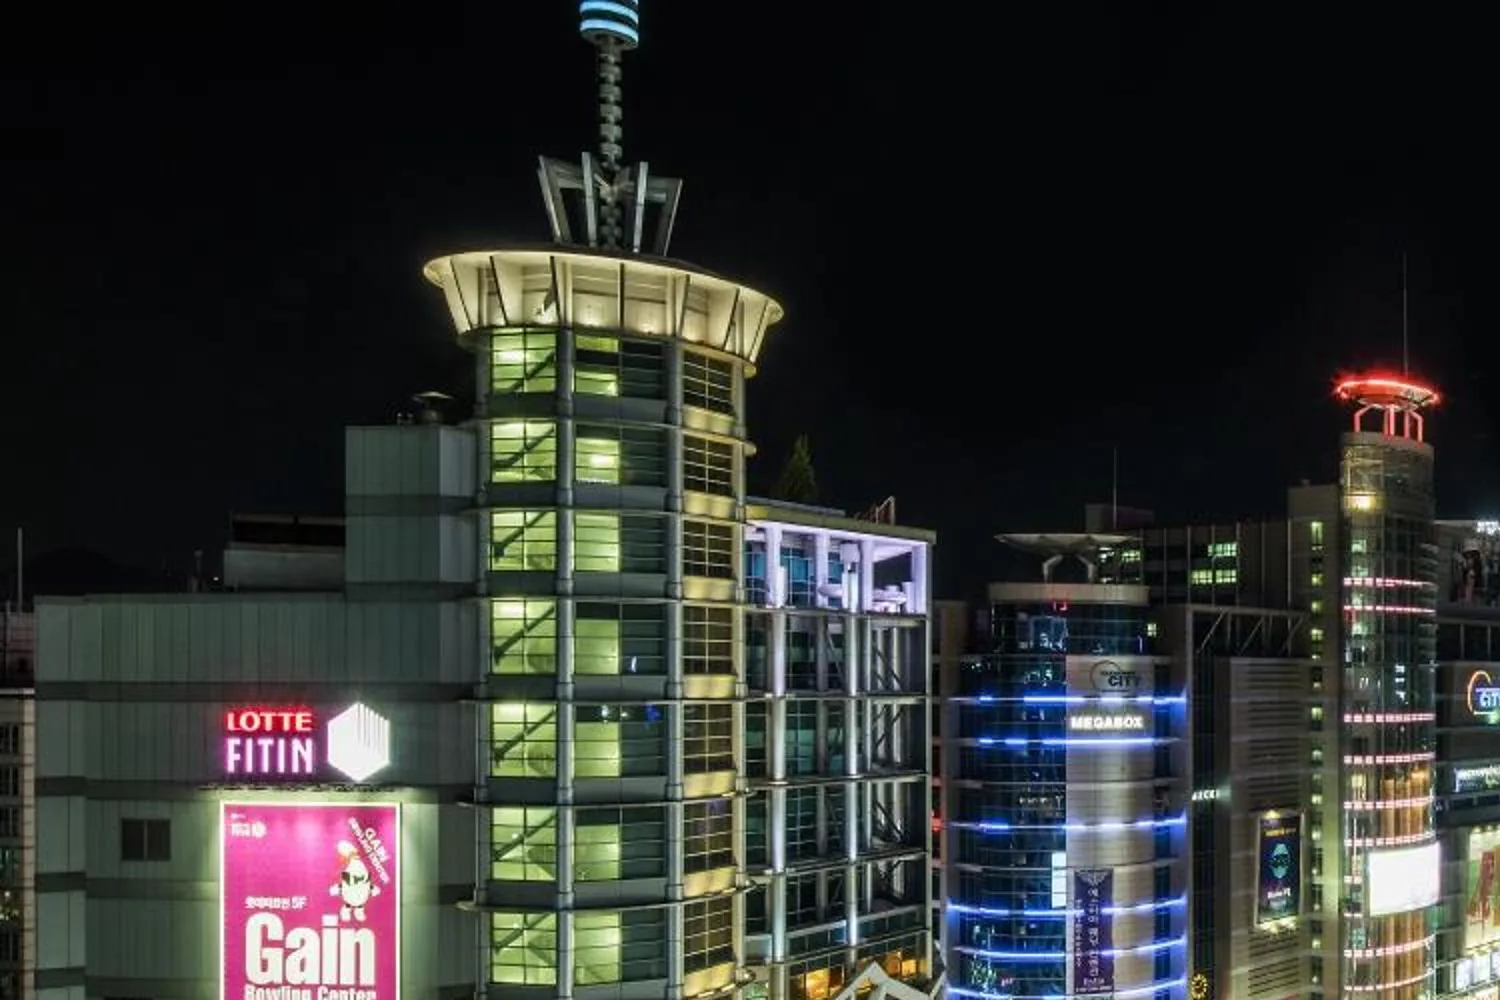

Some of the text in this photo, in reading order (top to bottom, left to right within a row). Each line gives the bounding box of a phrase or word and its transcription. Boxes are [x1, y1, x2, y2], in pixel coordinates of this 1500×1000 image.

[226, 711, 313, 732] LOTTE
[1070, 715, 1145, 730] MEGABOX
[226, 738, 313, 774] FITIN
[245, 911, 376, 986] Gain
